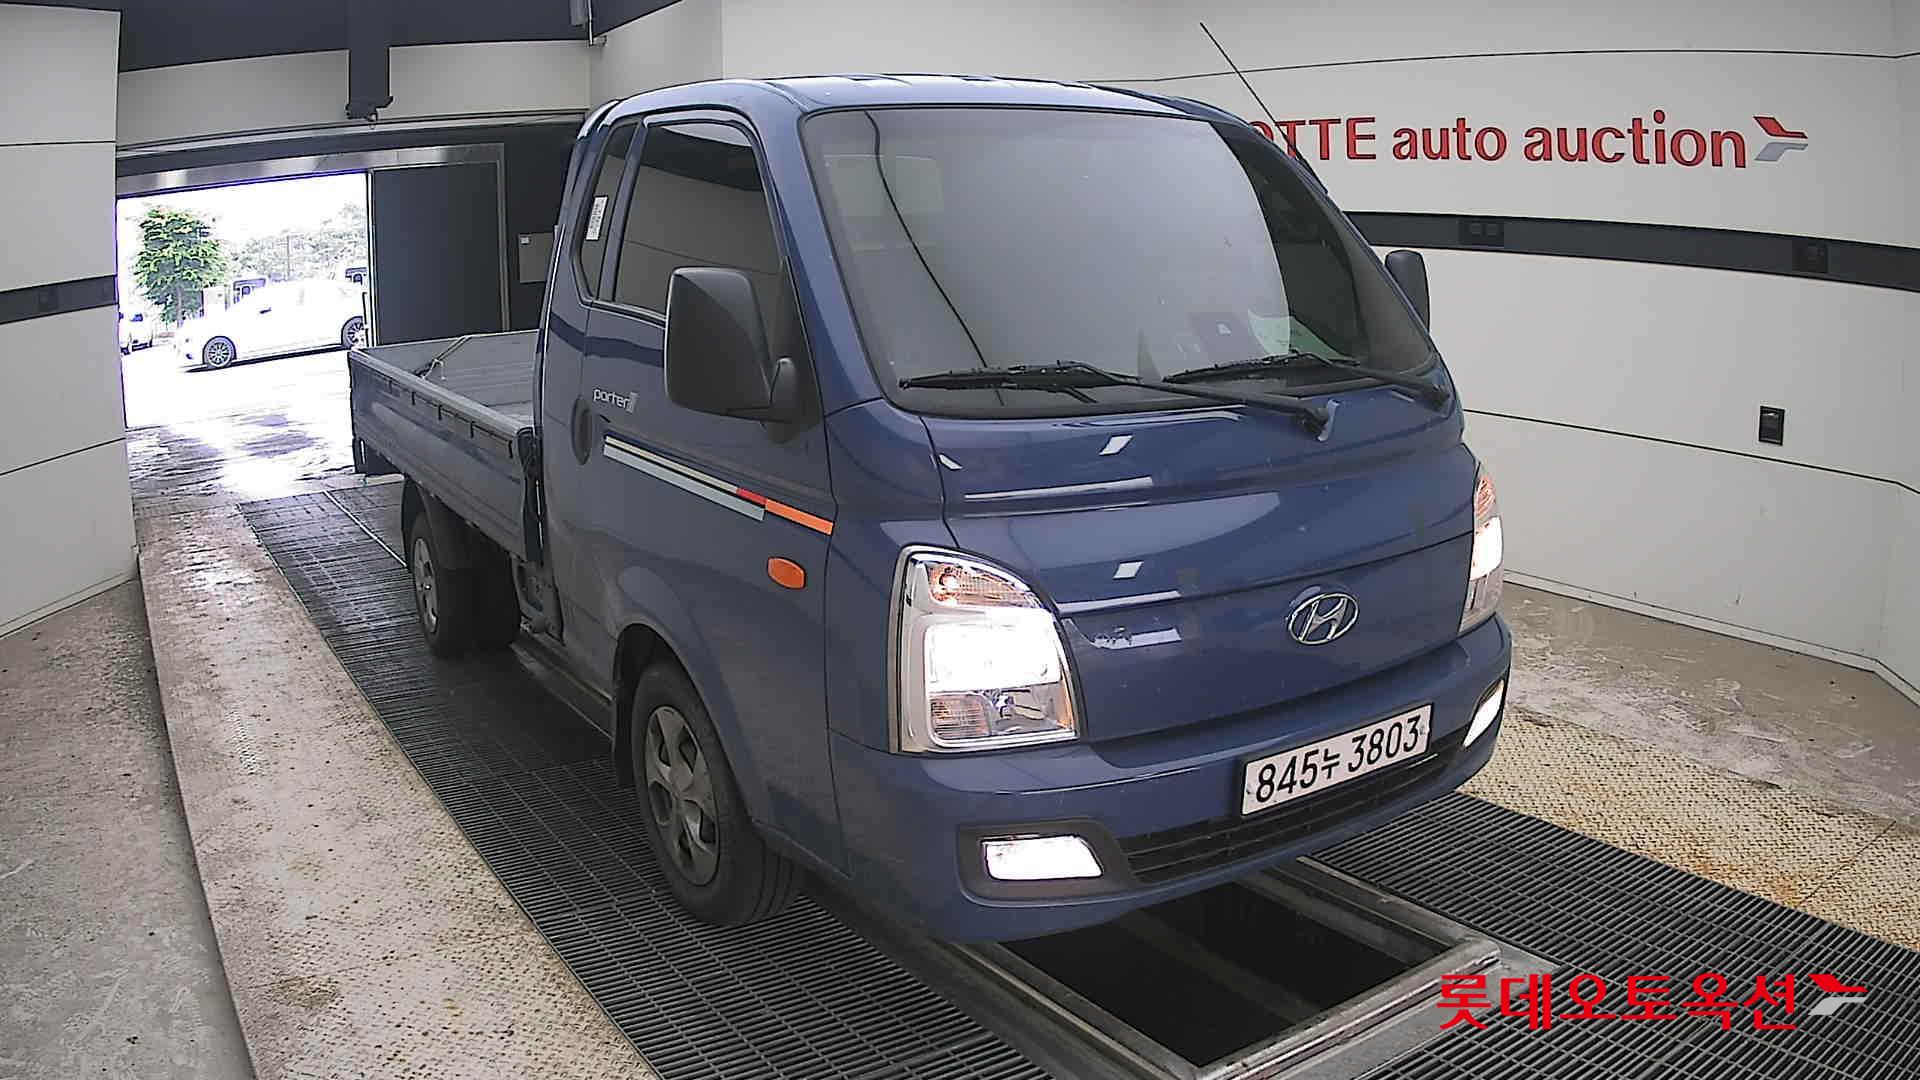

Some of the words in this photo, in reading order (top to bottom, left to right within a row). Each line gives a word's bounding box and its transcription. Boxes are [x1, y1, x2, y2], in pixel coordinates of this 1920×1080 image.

[1392, 117, 1509, 162] auto
[1522, 109, 1747, 169] auction
[1256, 748, 1340, 802] 845누
[1348, 715, 1421, 773] 3803
